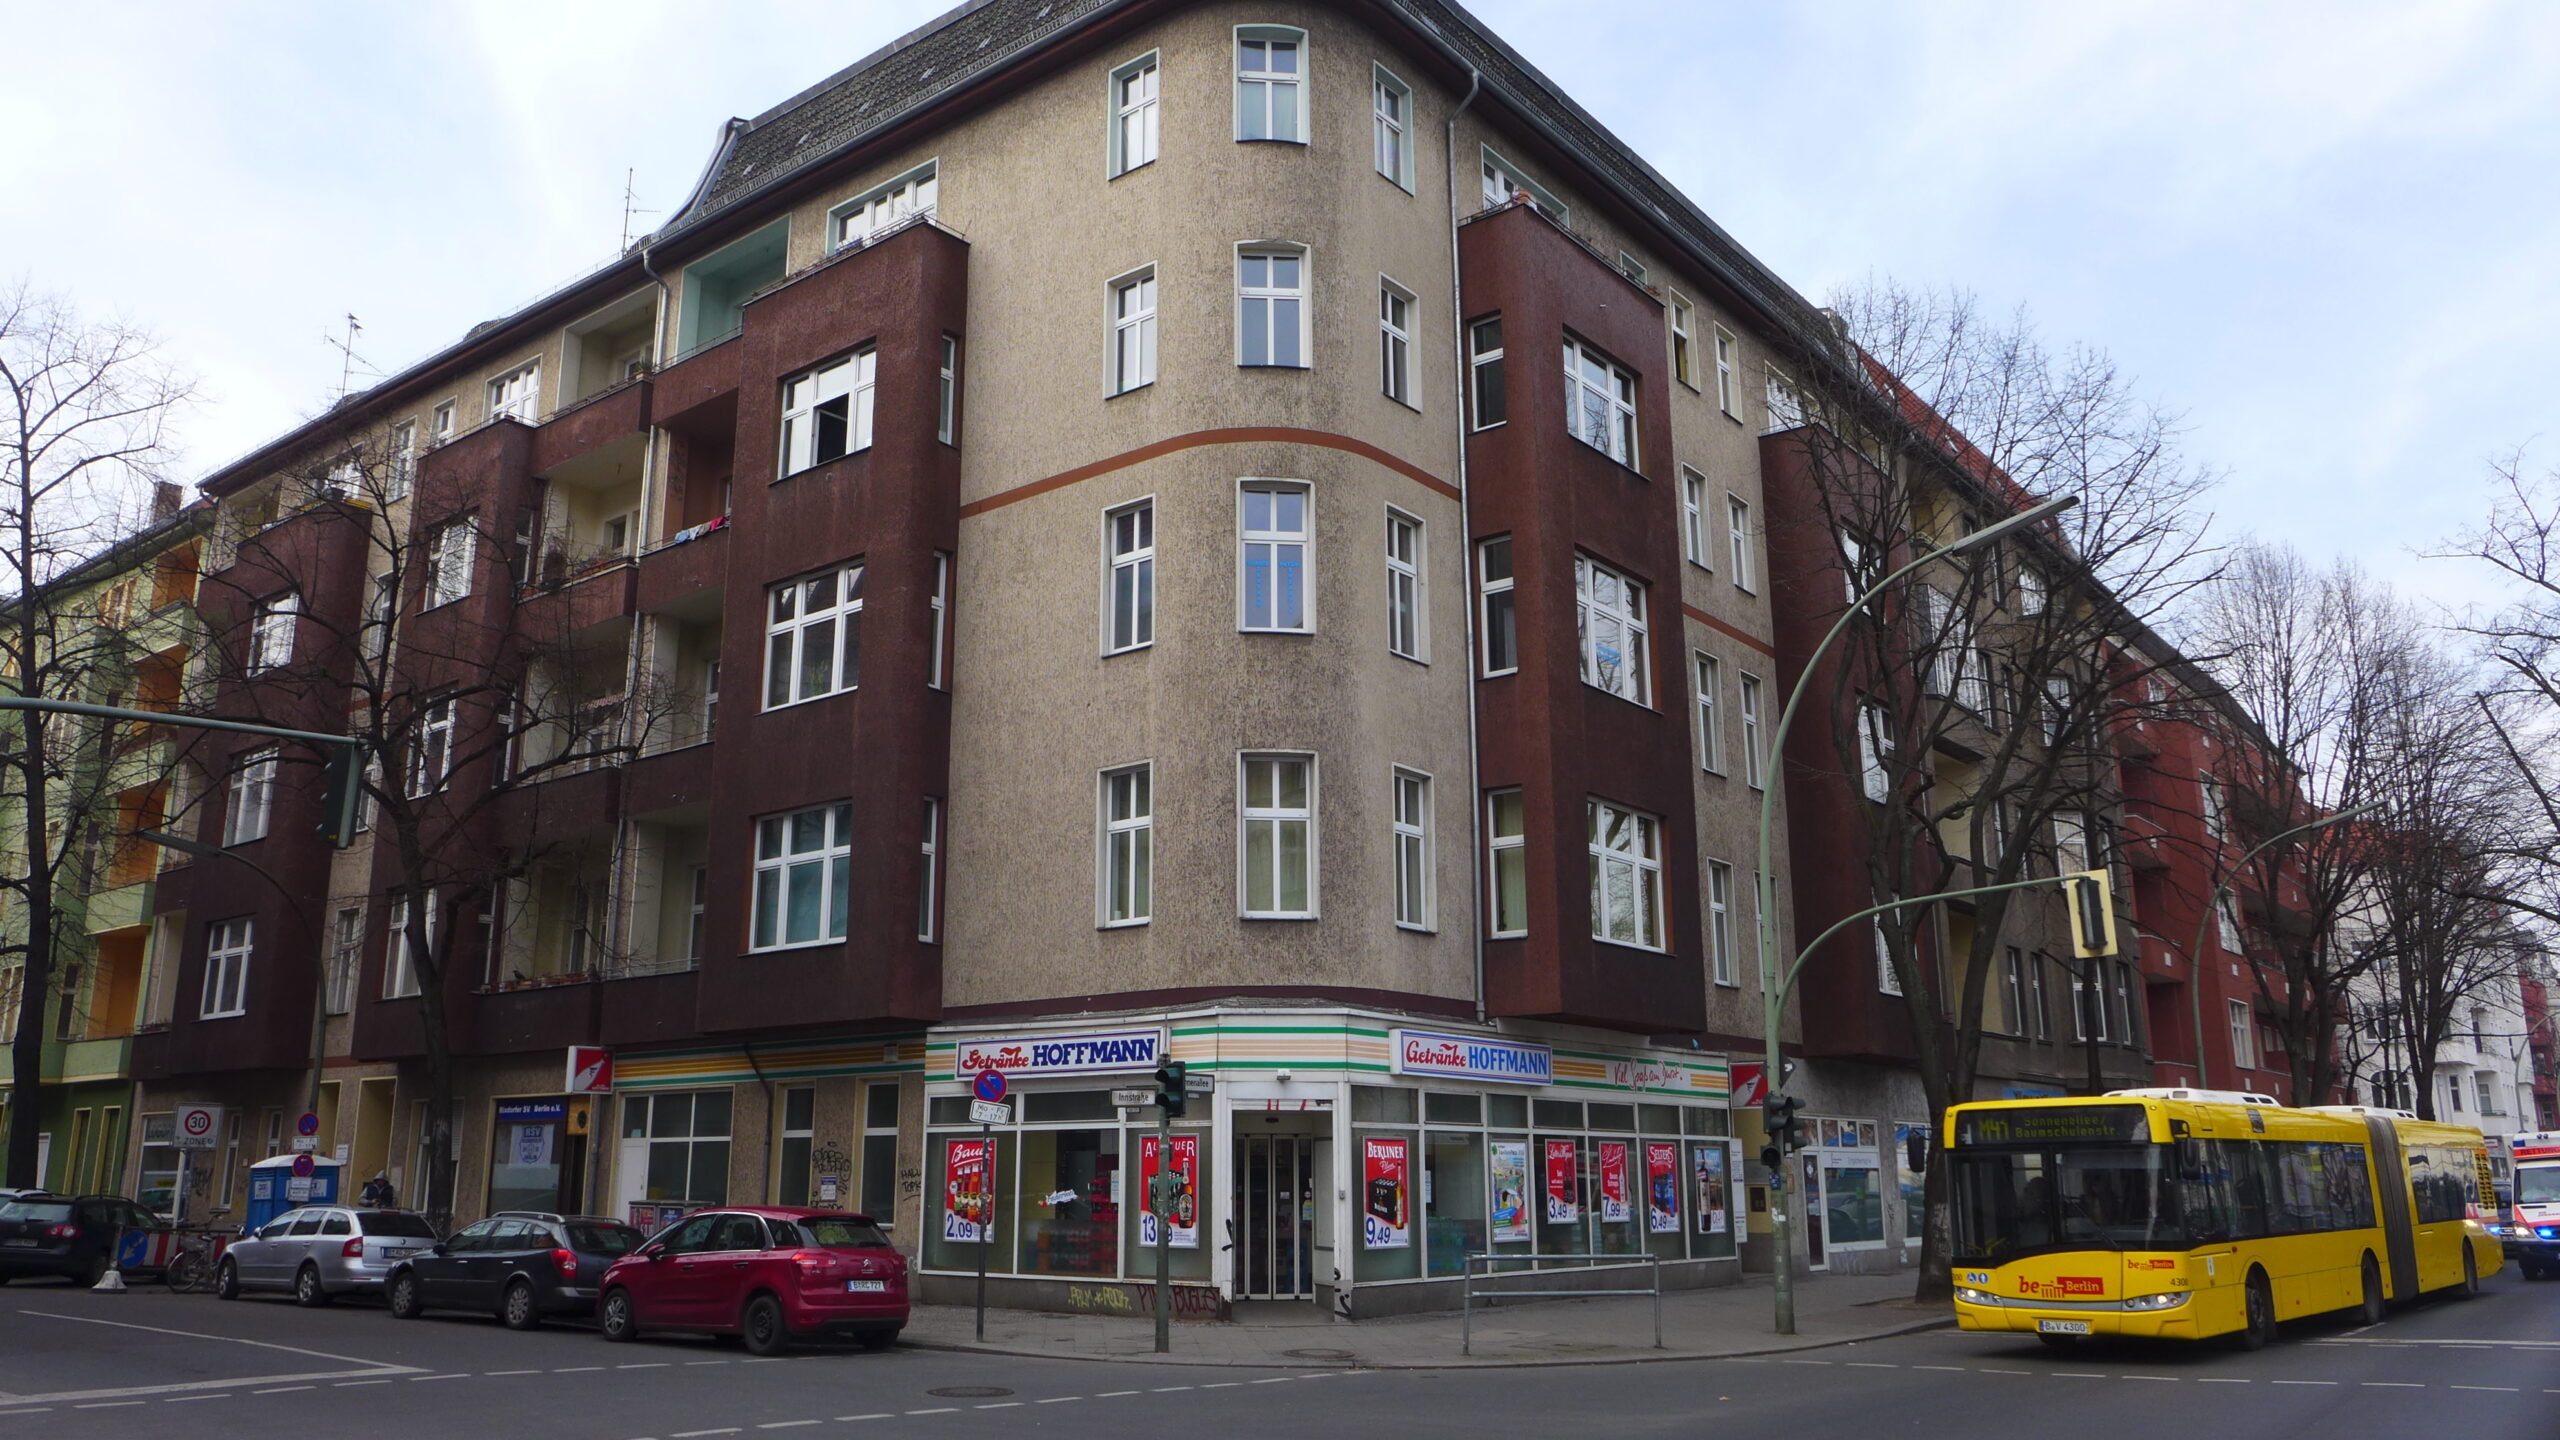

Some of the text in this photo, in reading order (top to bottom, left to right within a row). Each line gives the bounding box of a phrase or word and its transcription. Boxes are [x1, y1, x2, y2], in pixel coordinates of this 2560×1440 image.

[962, 1038, 1155, 1070] Getränke HOFFMANN
[1406, 1040, 1547, 1075] Getränke HOFFMANN
[1614, 1063, 1628, 1085] Viel
[1118, 1091, 1149, 1104] Innstraße
[522, 1105, 531, 1113] SV
[533, 1104, 550, 1113] Berlin
[977, 1104, 988, 1112] Mo
[996, 1107, 1004, 1115] Fr
[190, 1117, 206, 1129] 30
[525, 1127, 541, 1136] RSV
[183, 1137, 208, 1145] ZONE
[1367, 1141, 1404, 1160] BERLINER
[1549, 1196, 1567, 1219] 3,49
[1602, 1196, 1620, 1217] 7,99
[946, 1213, 972, 1238] 2,09
[1650, 1207, 1667, 1229] 6,49
[1366, 1216, 1391, 1246] 9,49
[2127, 1259, 2139, 1269] be
[2018, 1275, 2101, 1294] be Berlin
[2045, 1321, 2051, 1330] B
[2063, 1323, 2086, 1332] 4300
